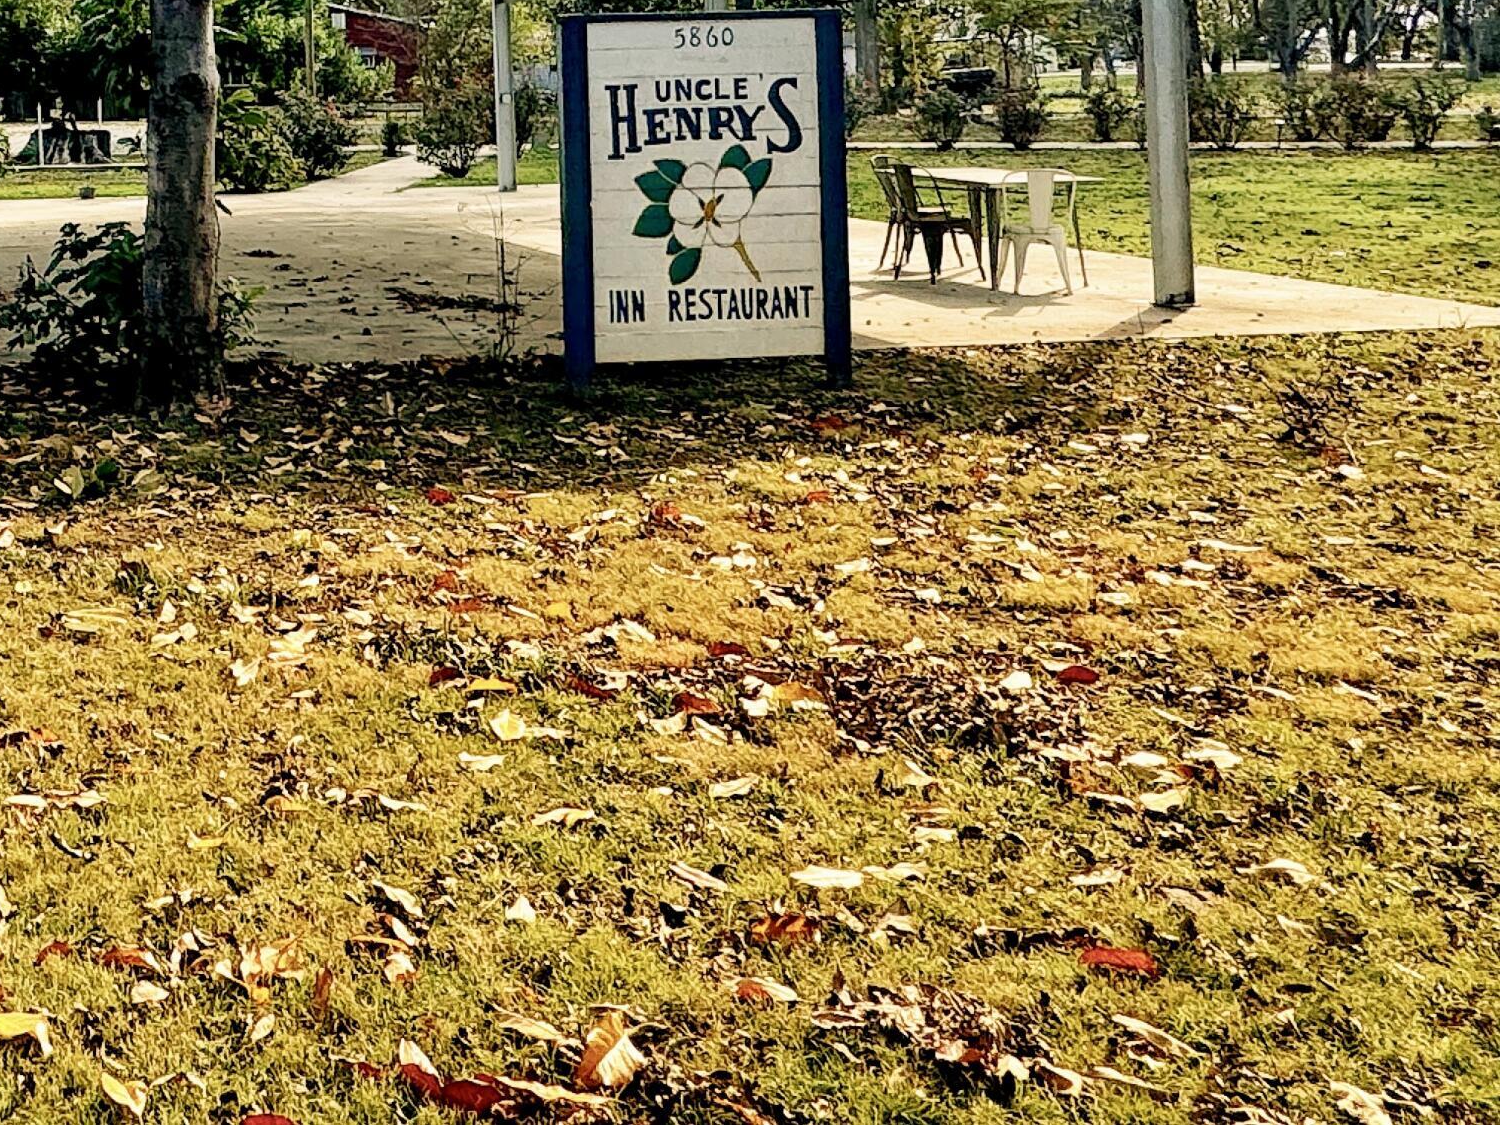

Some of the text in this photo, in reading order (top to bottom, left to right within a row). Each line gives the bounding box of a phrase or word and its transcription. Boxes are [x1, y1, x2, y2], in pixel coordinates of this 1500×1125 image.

[674, 27, 734, 48] 5860
[655, 78, 749, 103] UNCLE
[605, 74, 803, 160] HENRY'S
[609, 286, 814, 323] INN RESTAURANT
